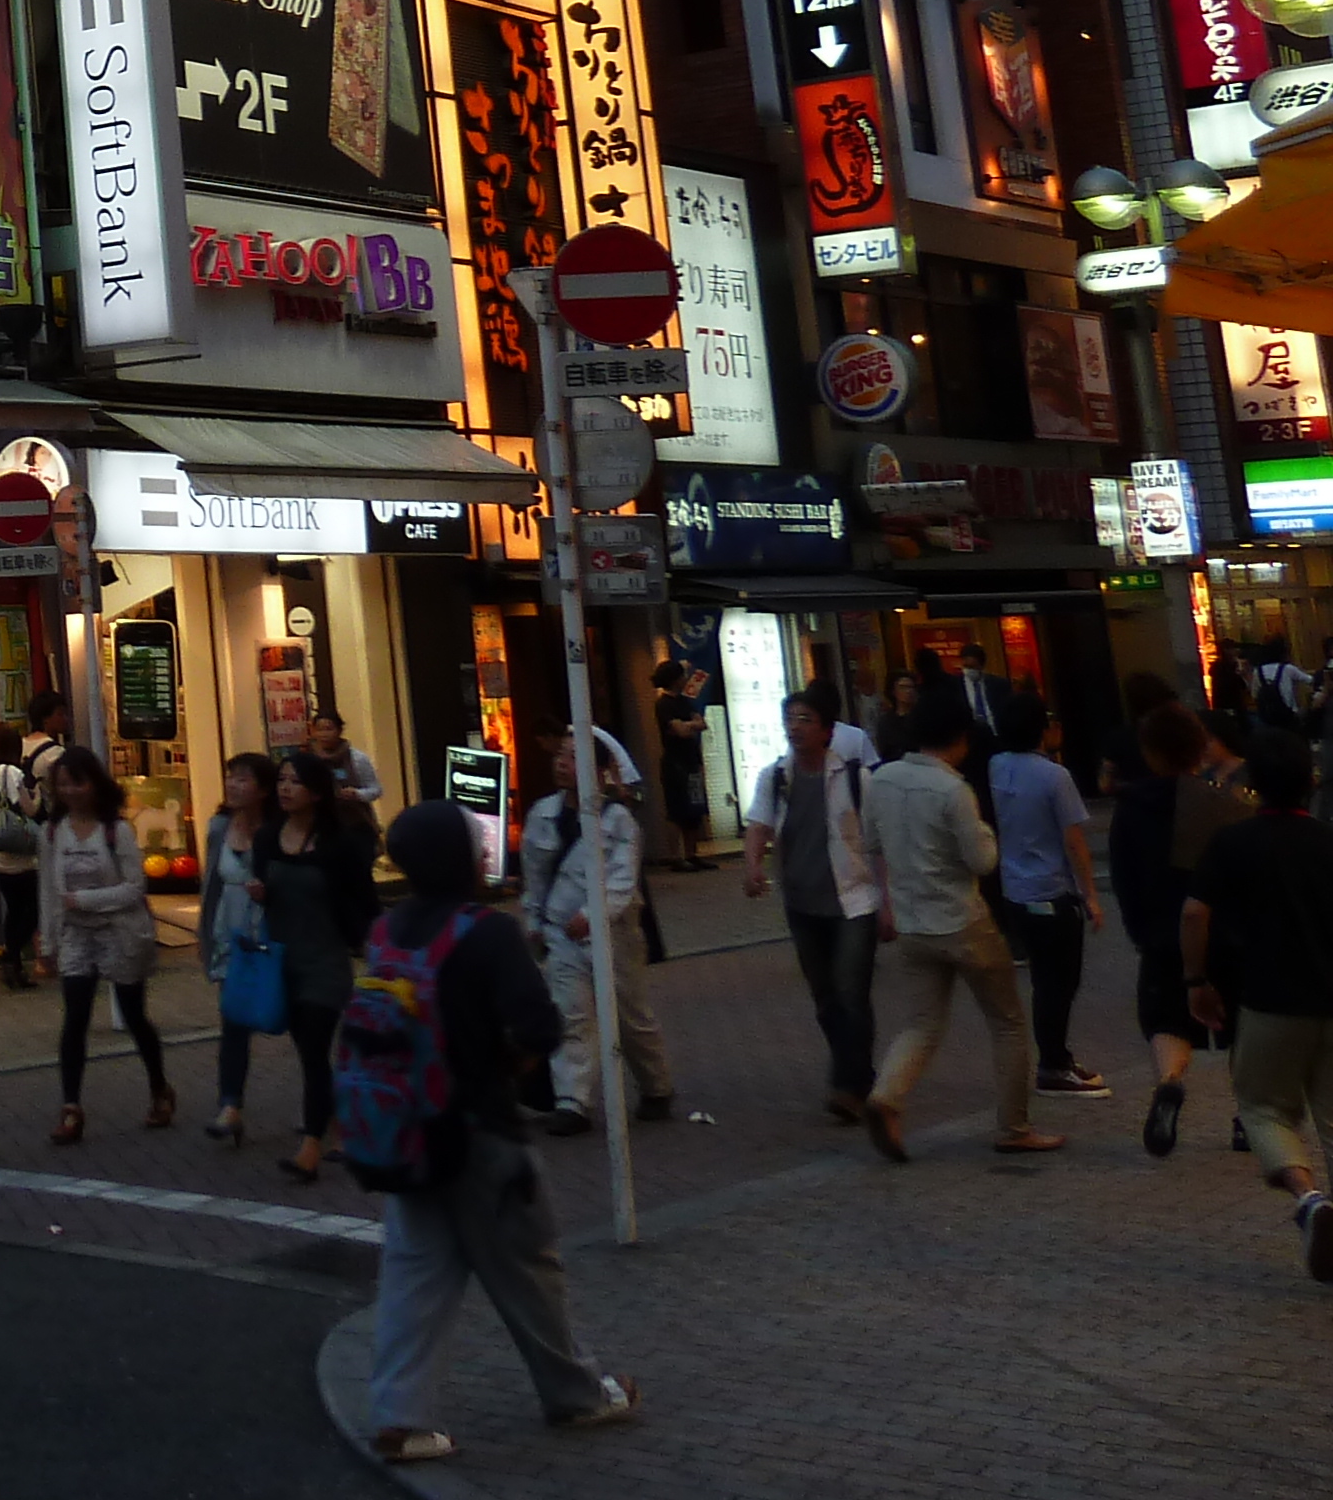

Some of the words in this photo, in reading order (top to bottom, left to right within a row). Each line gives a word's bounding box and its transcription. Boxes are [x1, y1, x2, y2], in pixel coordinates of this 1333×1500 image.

[567, 0, 638, 171] ちりとり鍋
[1213, 82, 1245, 102] 4F
[236, 68, 289, 136] 2F
[82, 43, 140, 308] SoftBank
[189, 225, 359, 292] YAHOO!
[362, 233, 434, 312] BB
[818, 239, 897, 267] センタービル
[564, 361, 681, 388] 自転車を除く
[829, 350, 888, 382] BURGER
[834, 368, 893, 399] KING
[1168, 463, 1176, 474] A
[188, 483, 321, 532] SoftBank
[404, 522, 439, 541] CAFE
